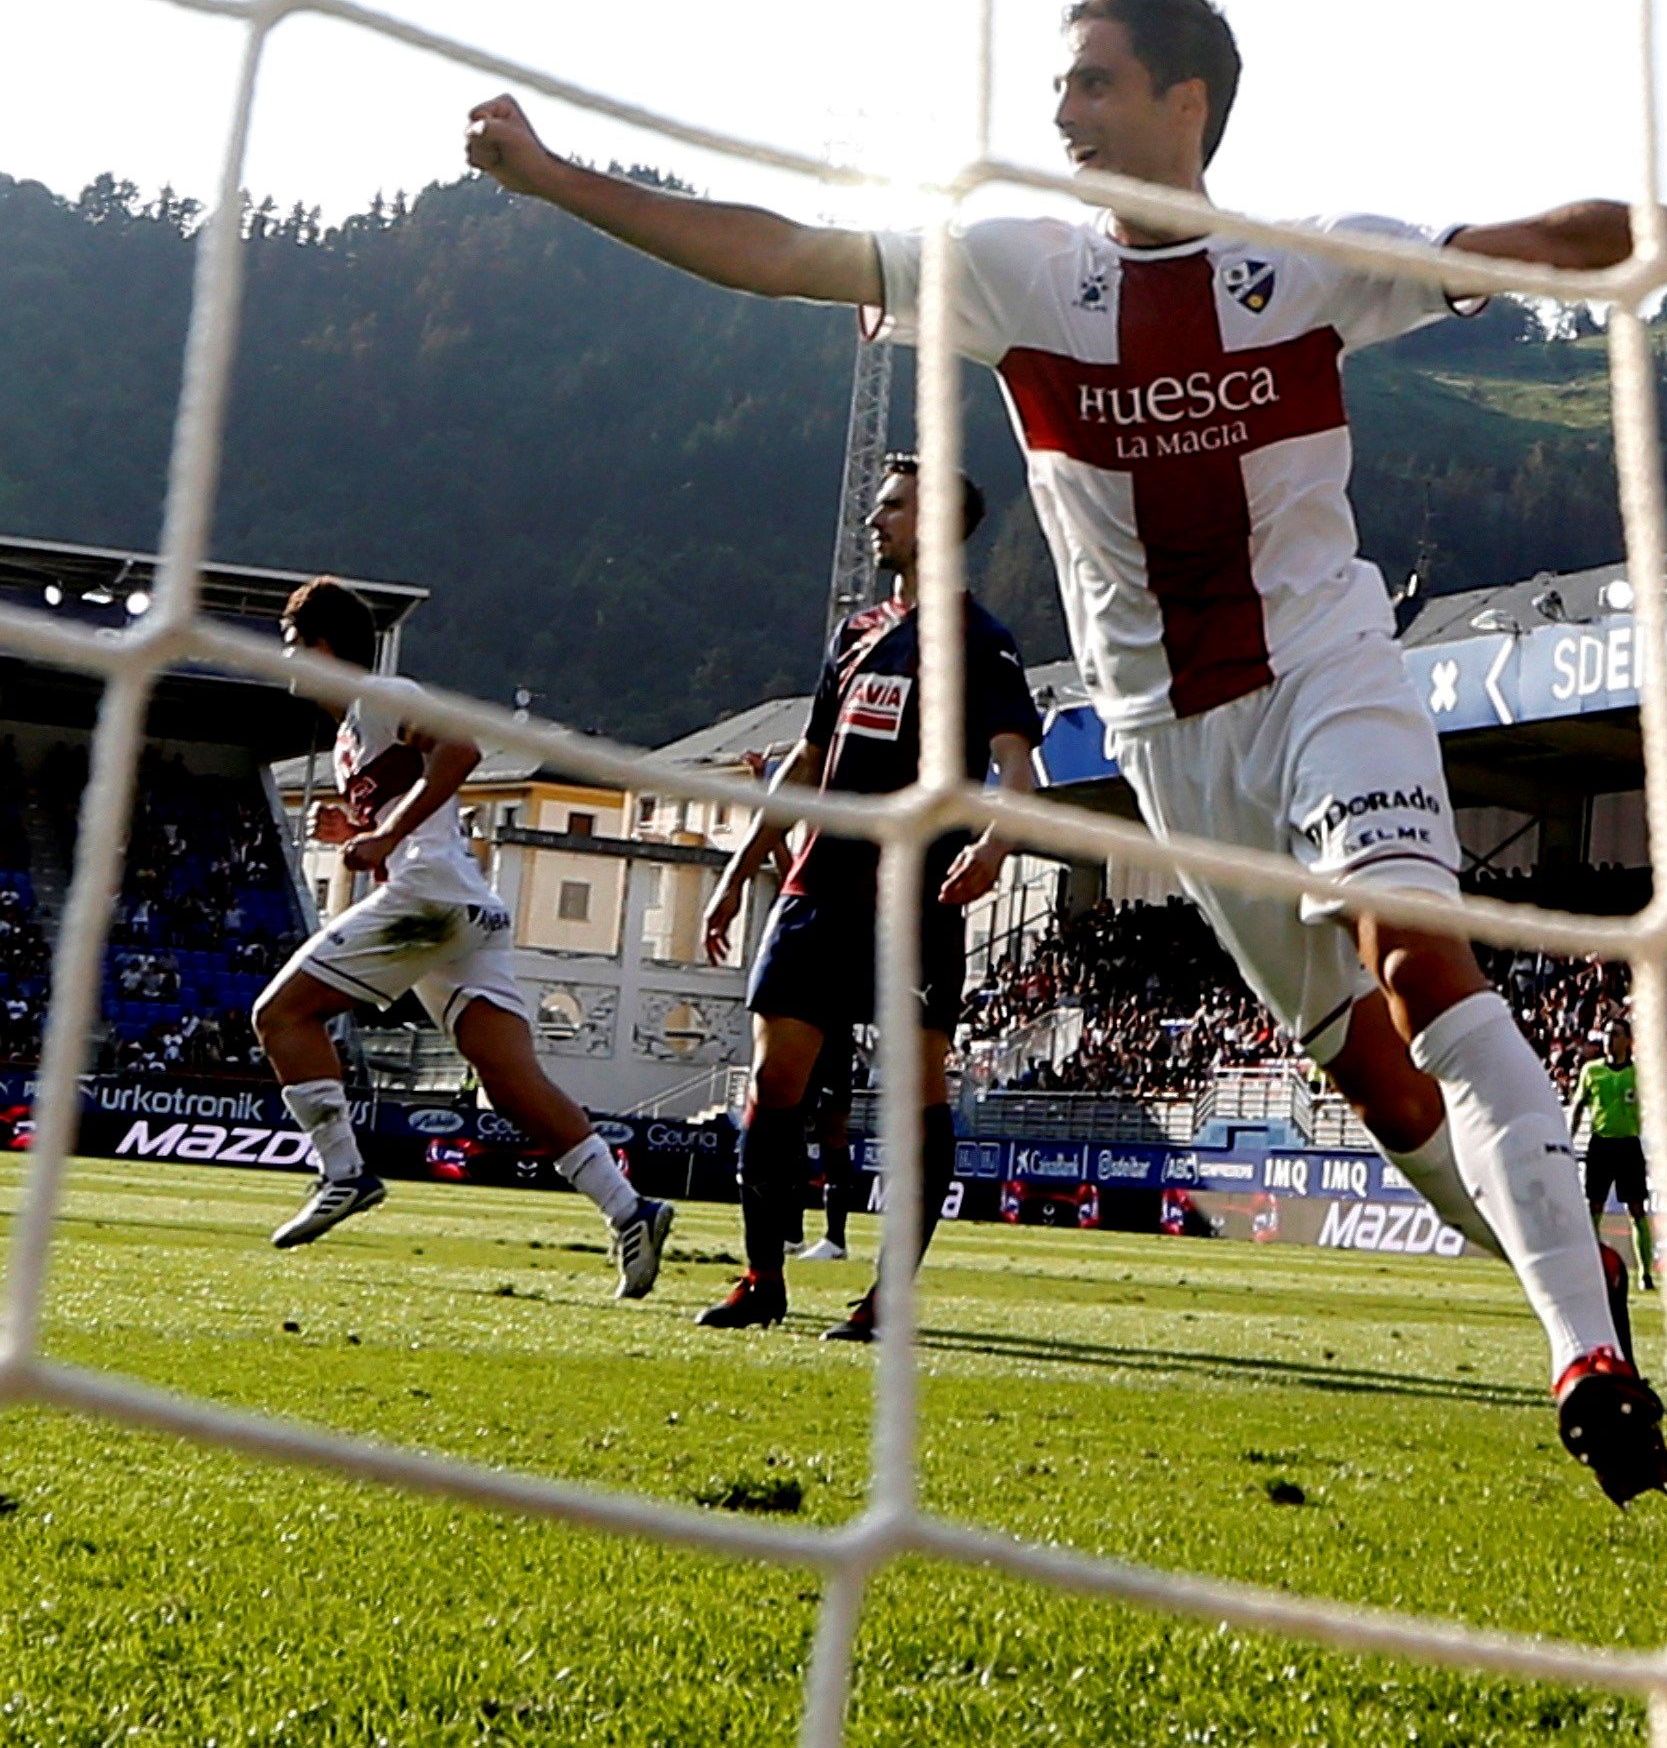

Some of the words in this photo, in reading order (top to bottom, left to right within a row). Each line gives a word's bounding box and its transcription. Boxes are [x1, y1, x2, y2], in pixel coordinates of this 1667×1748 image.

[1346, 826, 1432, 853] ELME
[101, 1084, 263, 1121] urkotronik
[1264, 1158, 1308, 1196] IMQ
[1322, 1158, 1367, 1198] IMQ
